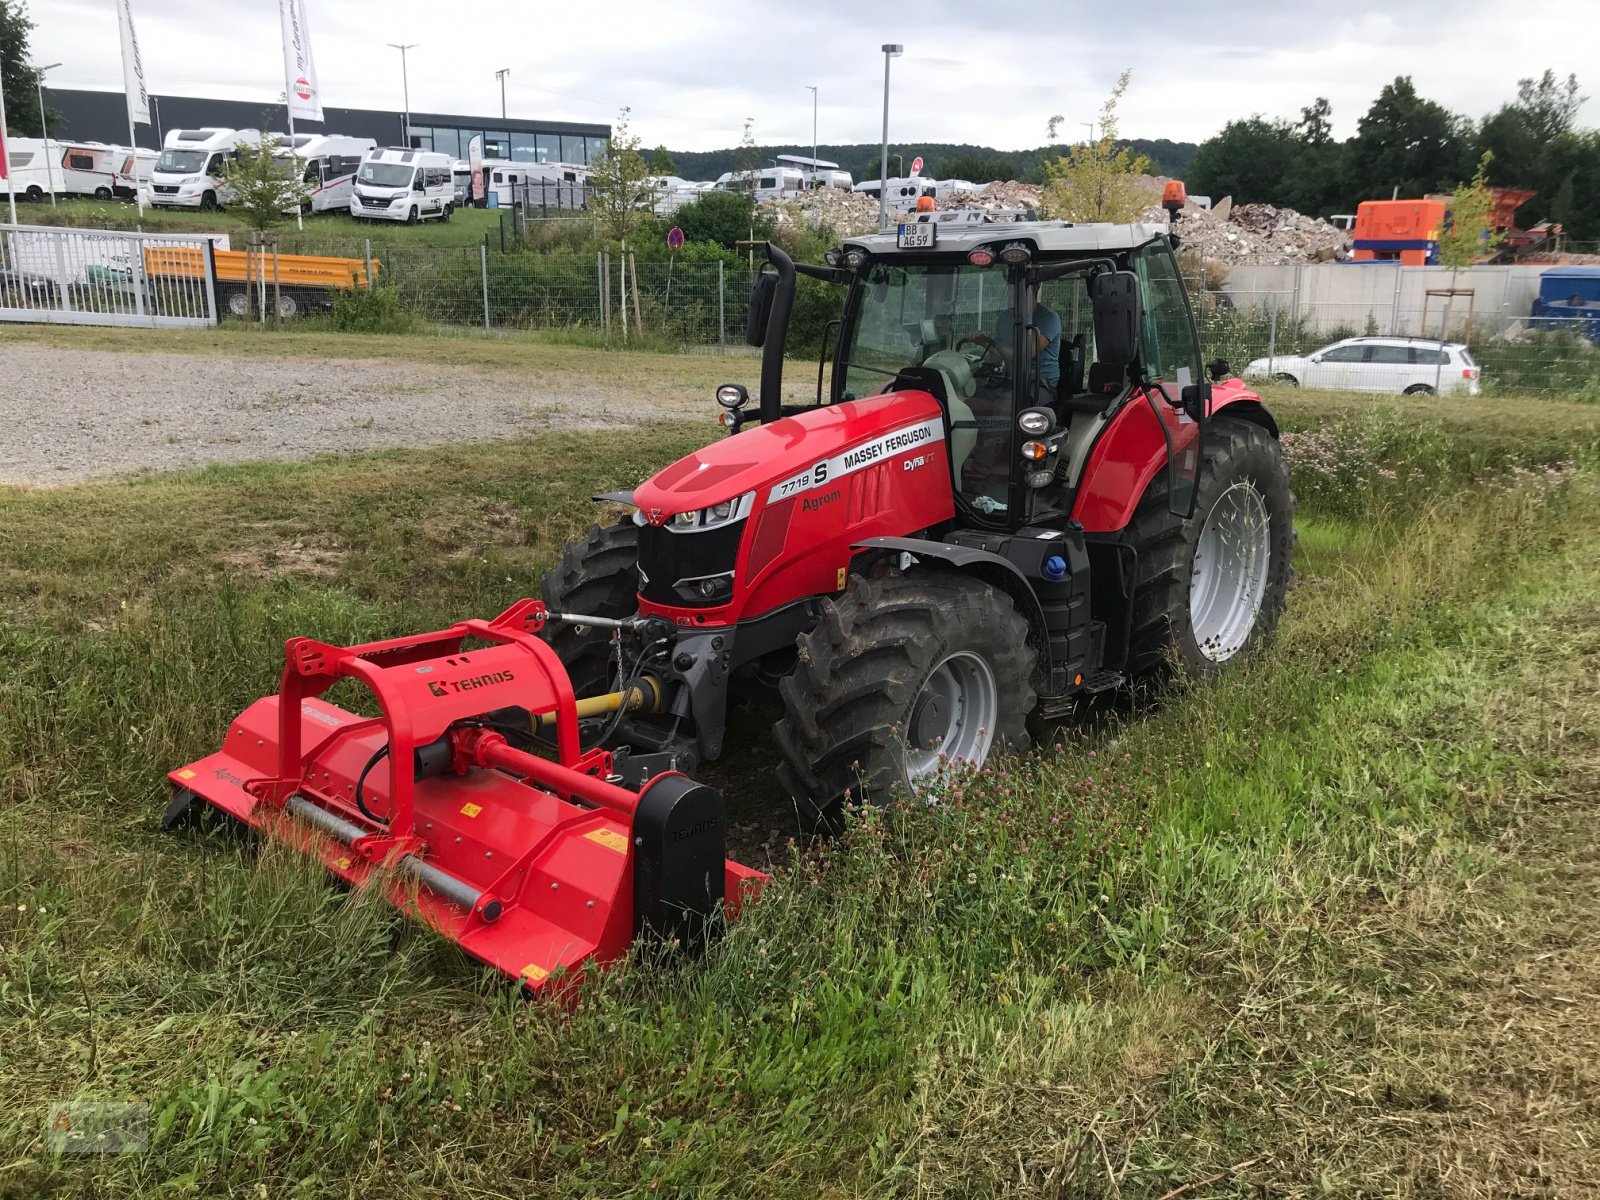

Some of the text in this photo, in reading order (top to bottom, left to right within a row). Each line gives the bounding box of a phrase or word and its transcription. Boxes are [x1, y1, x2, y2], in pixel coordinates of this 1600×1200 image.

[904, 235, 927, 246] AG 59
[906, 225, 917, 235] BB
[781, 426, 931, 495] 7719 S MASSEY FERGUSON
[802, 490, 840, 512] Agrom
[450, 670, 514, 693] TEHNOS
